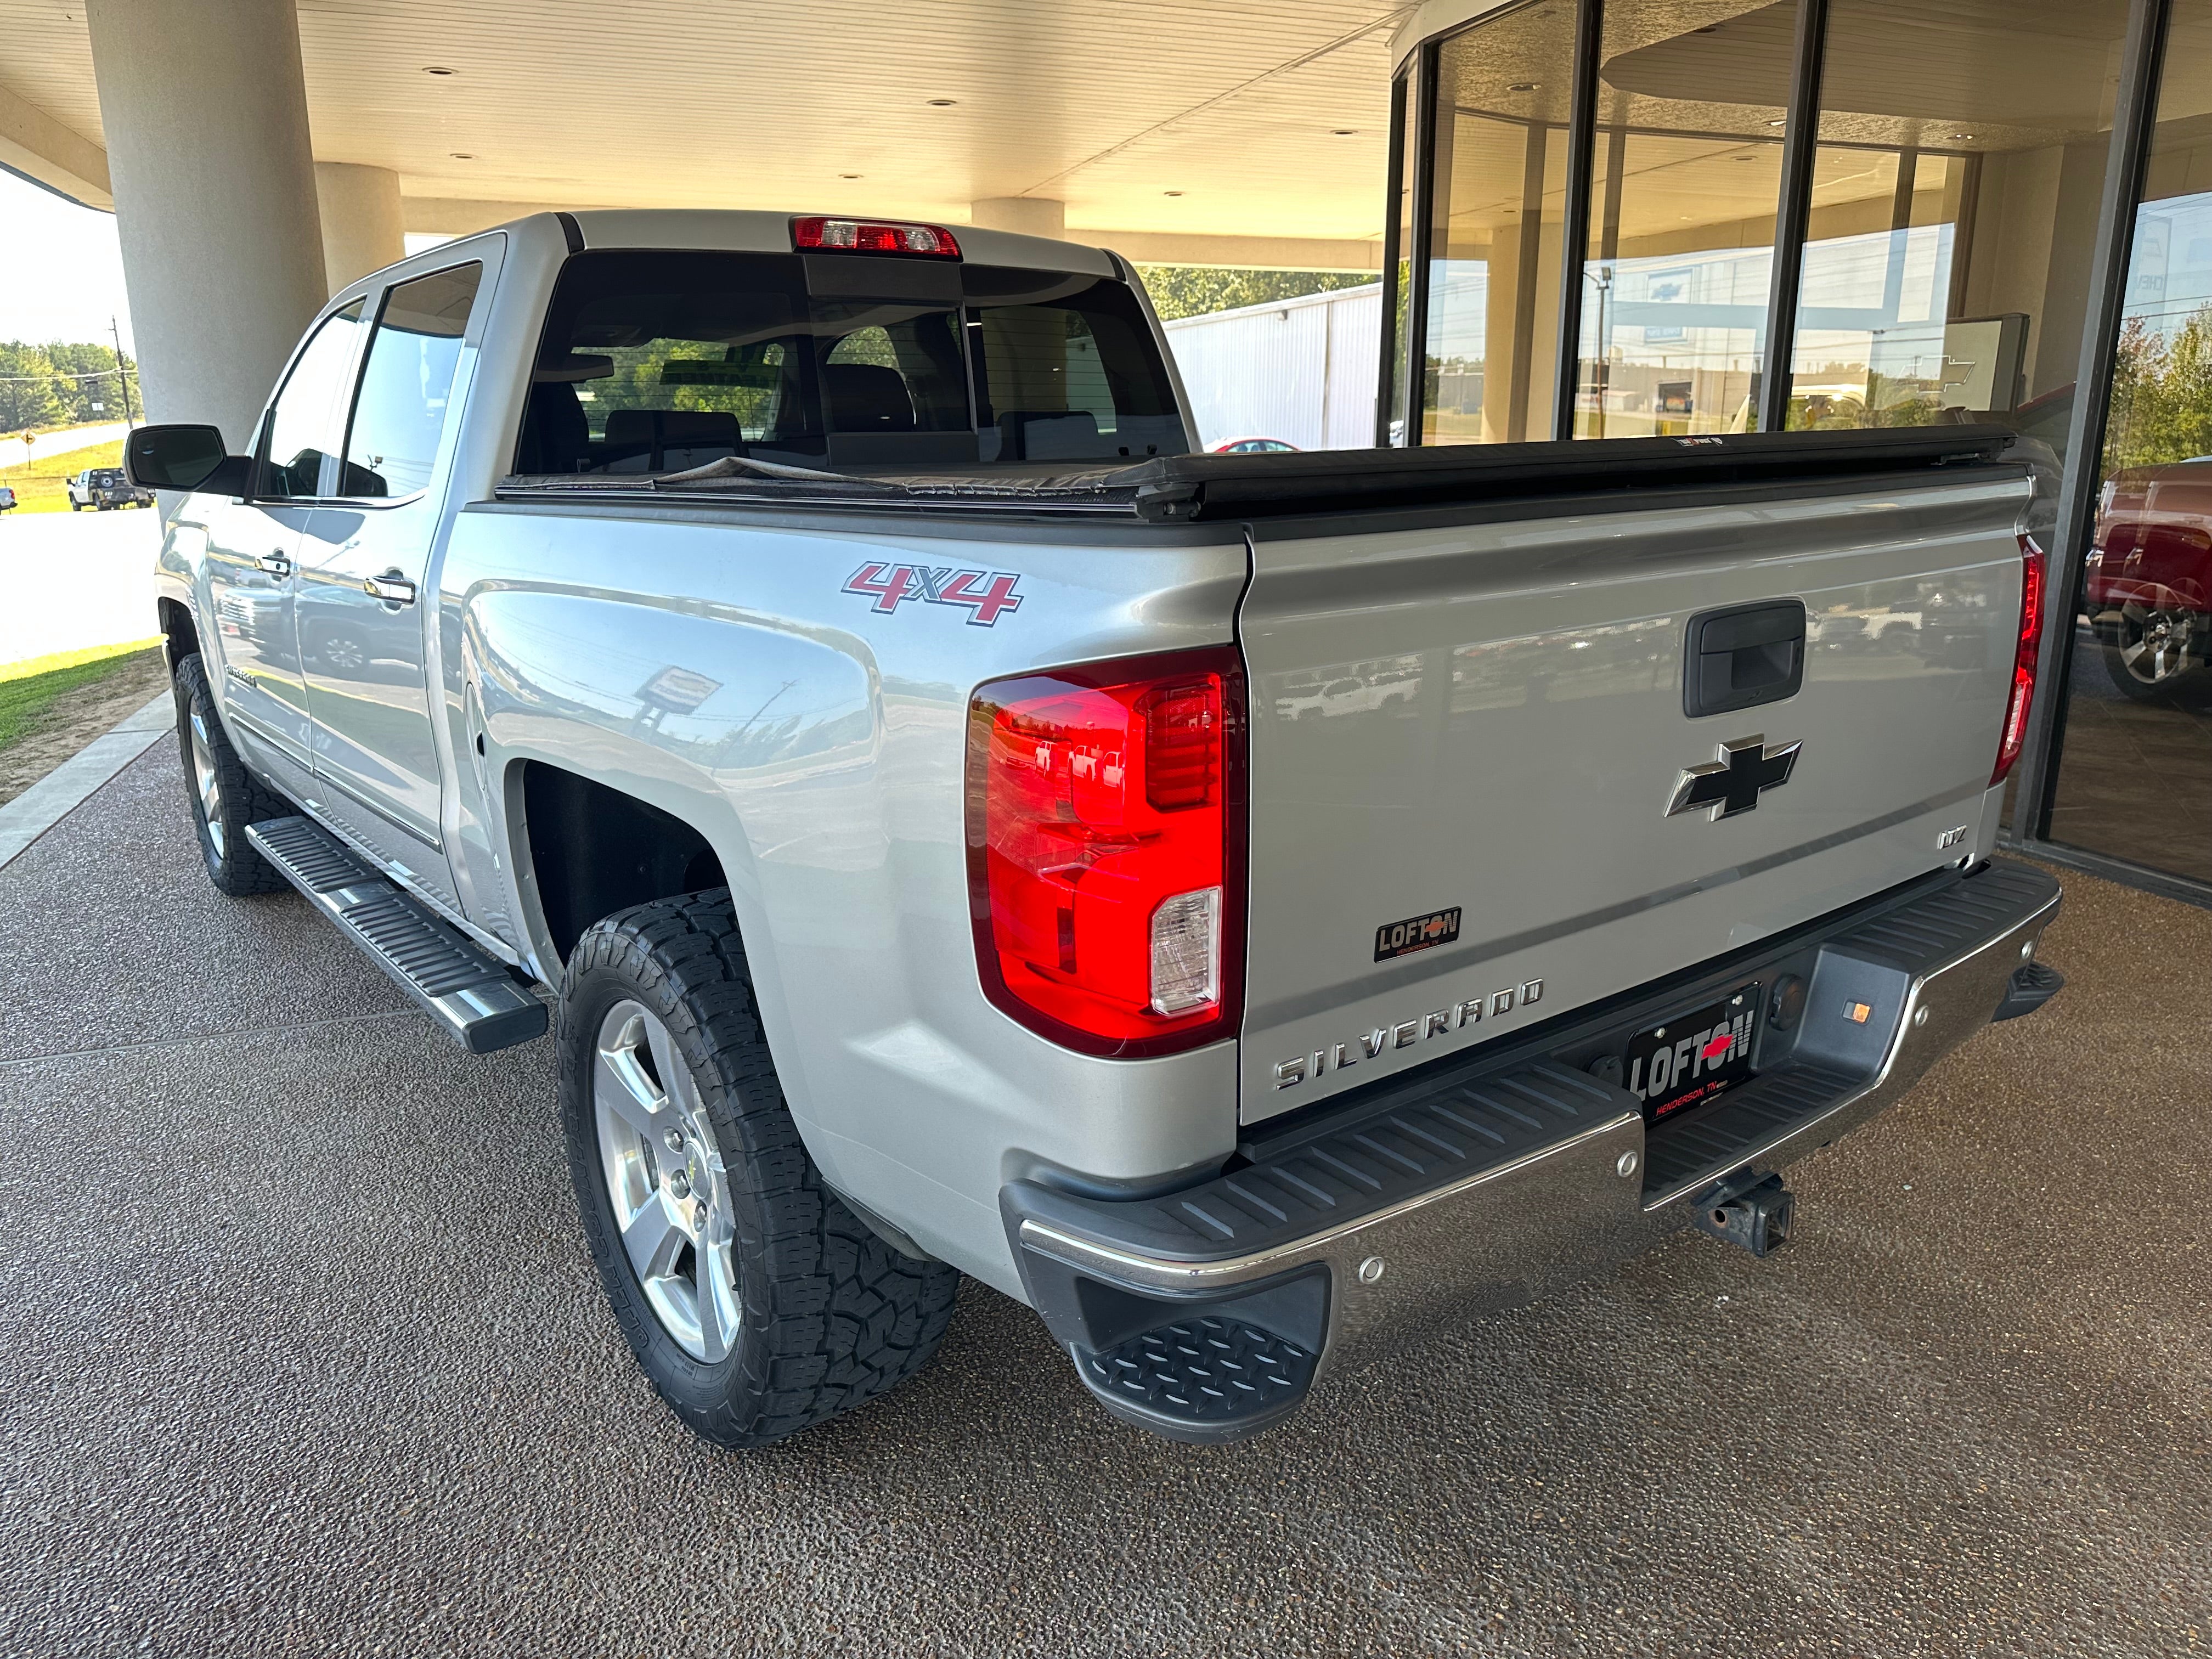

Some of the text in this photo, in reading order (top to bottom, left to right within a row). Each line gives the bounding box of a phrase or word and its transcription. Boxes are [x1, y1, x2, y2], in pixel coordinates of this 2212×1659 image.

[1379, 911, 1458, 952] LOFTON
[1276, 978, 1543, 1090] SILVERADO
[1630, 1010, 1754, 1102] LOFTON
[1656, 1080, 1718, 1117] HENDERSON, TN
